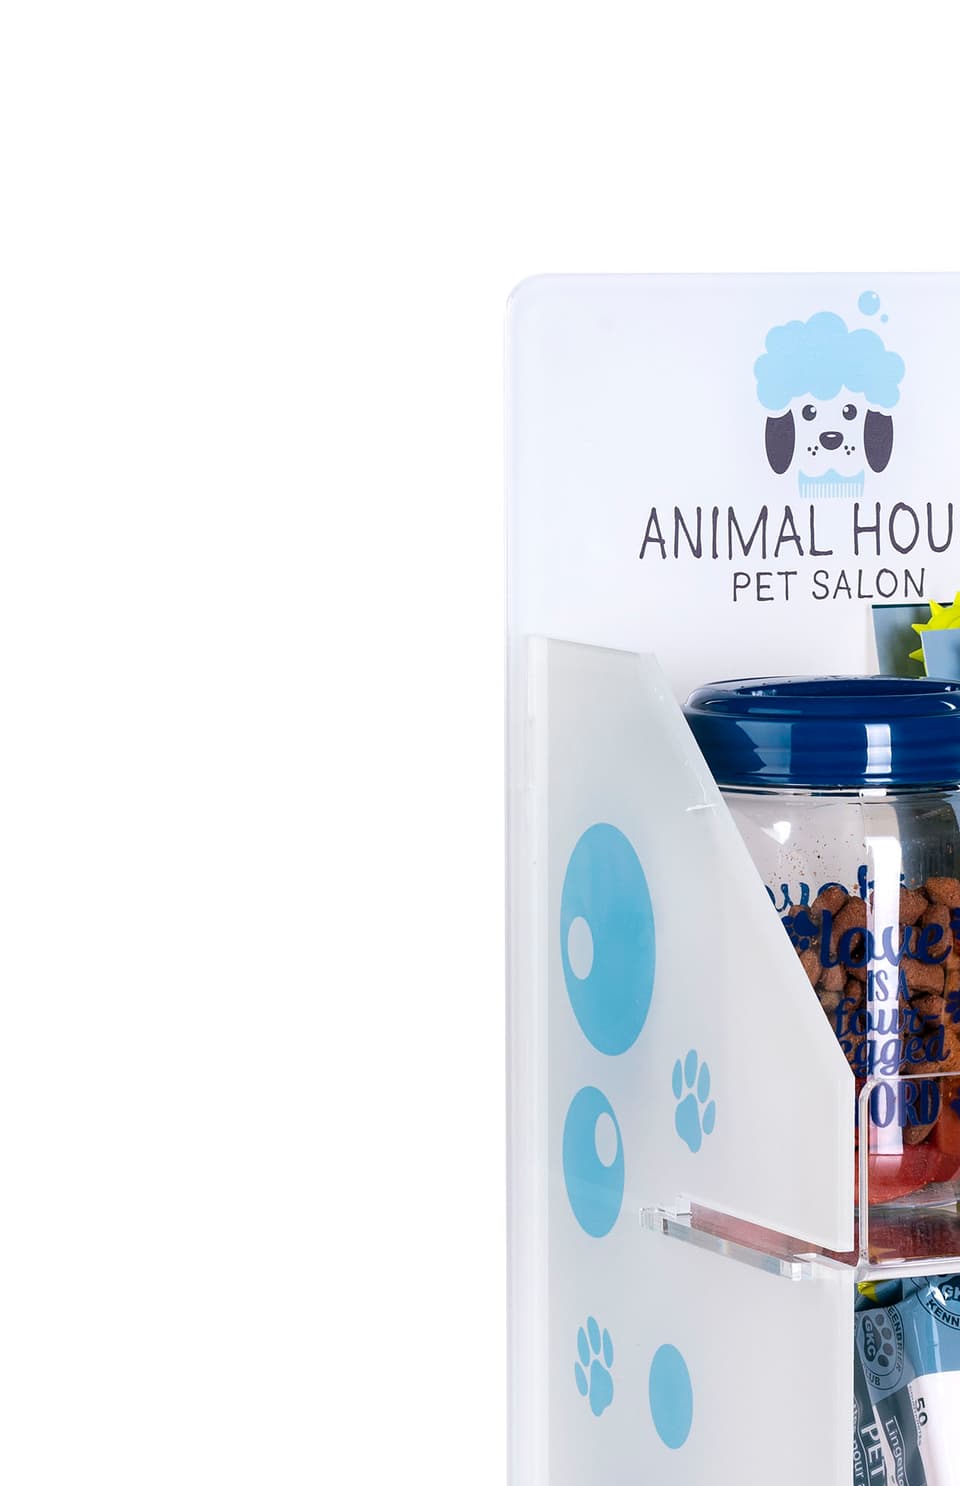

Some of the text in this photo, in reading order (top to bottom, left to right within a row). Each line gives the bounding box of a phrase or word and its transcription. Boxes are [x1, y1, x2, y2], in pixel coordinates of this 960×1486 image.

[638, 503, 833, 560] ANIMAL
[733, 567, 926, 601] PET SALON
[820, 908, 952, 969] love
[867, 968, 911, 1002] IS A
[840, 1024, 951, 1077] egged
[869, 1079, 940, 1129] ORD
[917, 1398, 928, 1427] 50
[861, 1423, 887, 1478] PET
